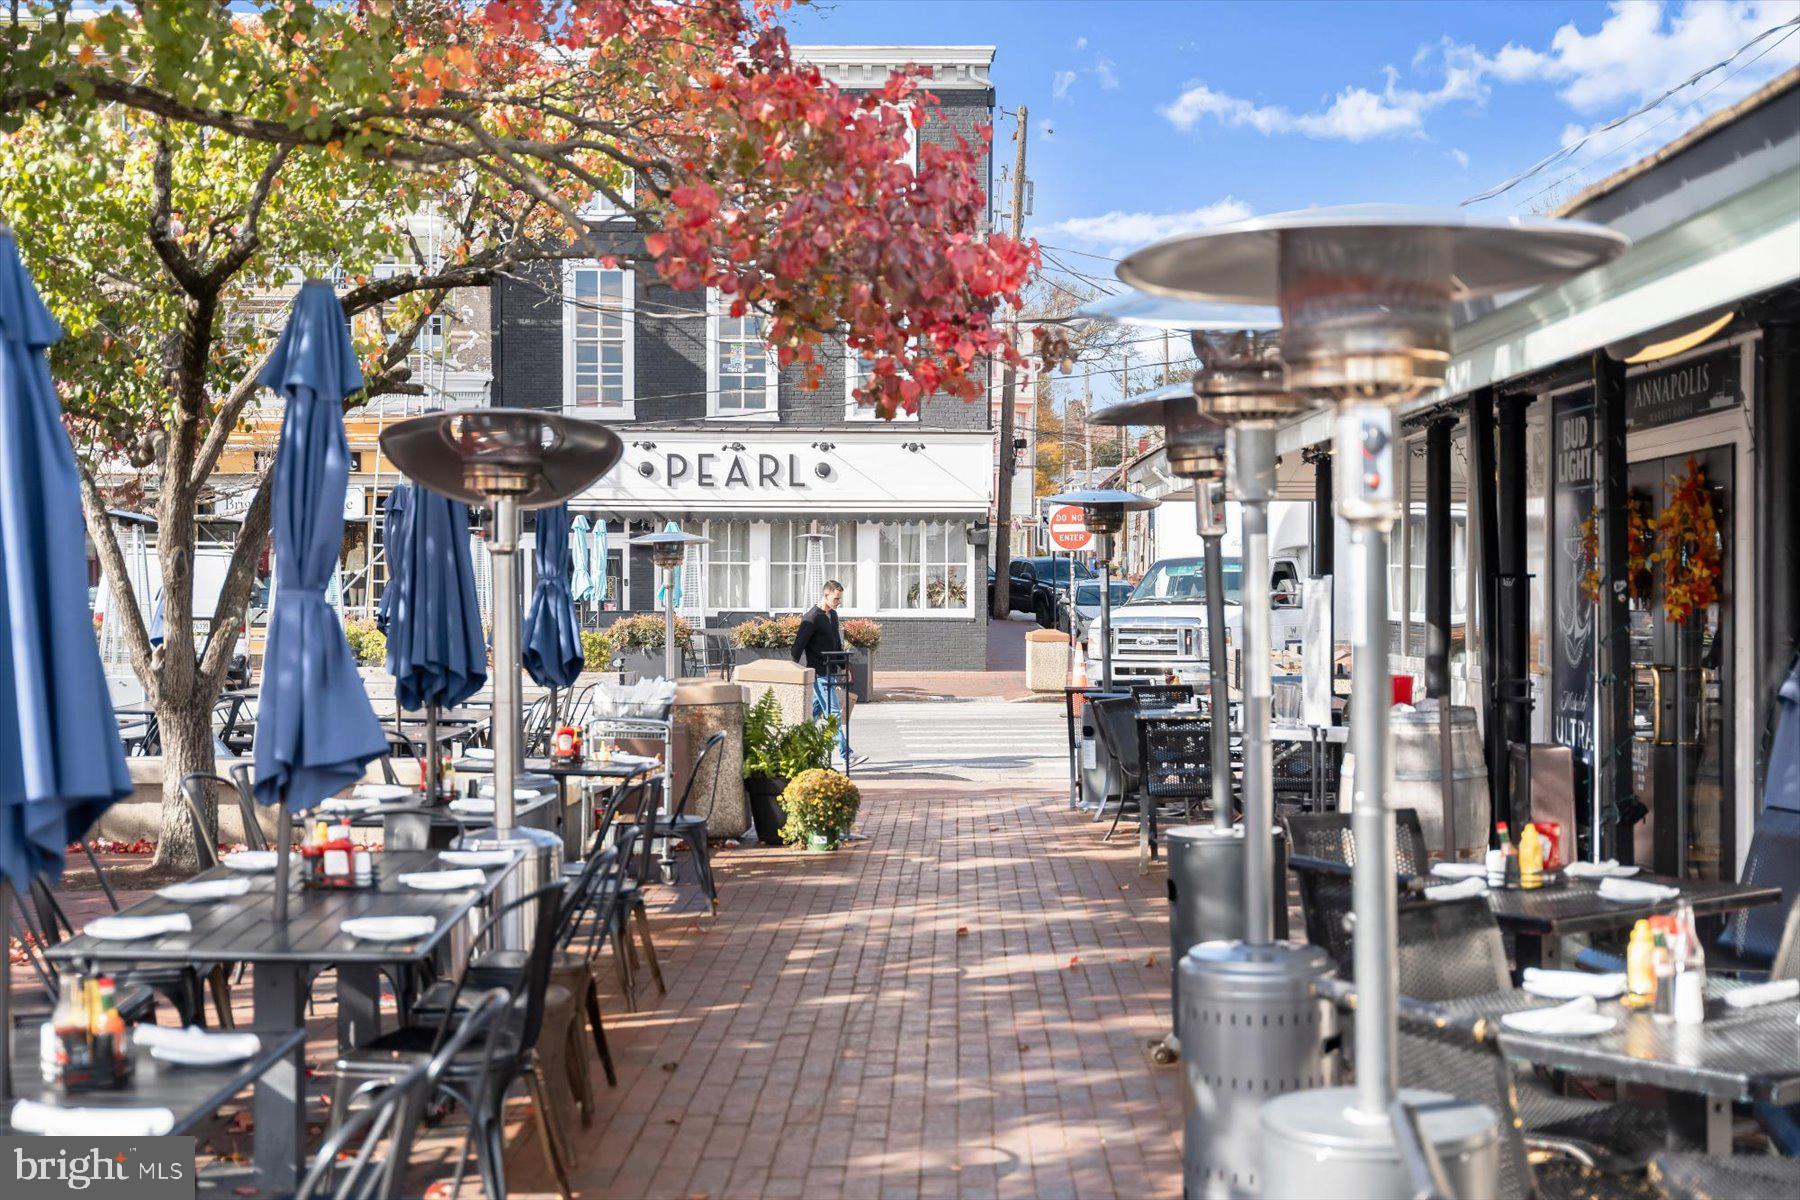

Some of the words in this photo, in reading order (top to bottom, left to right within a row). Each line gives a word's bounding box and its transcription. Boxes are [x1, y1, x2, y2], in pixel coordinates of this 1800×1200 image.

[1634, 362, 1710, 408] ANNAPOLIS
[1563, 416, 1588, 450] BUD
[667, 453, 806, 487] PEARL
[1558, 447, 1592, 483] LIGHT
[1055, 514, 1067, 522] DO
[1071, 514, 1085, 522] NO
[1059, 534, 1085, 542] ENTER
[1555, 714, 1594, 752] ULTRA
